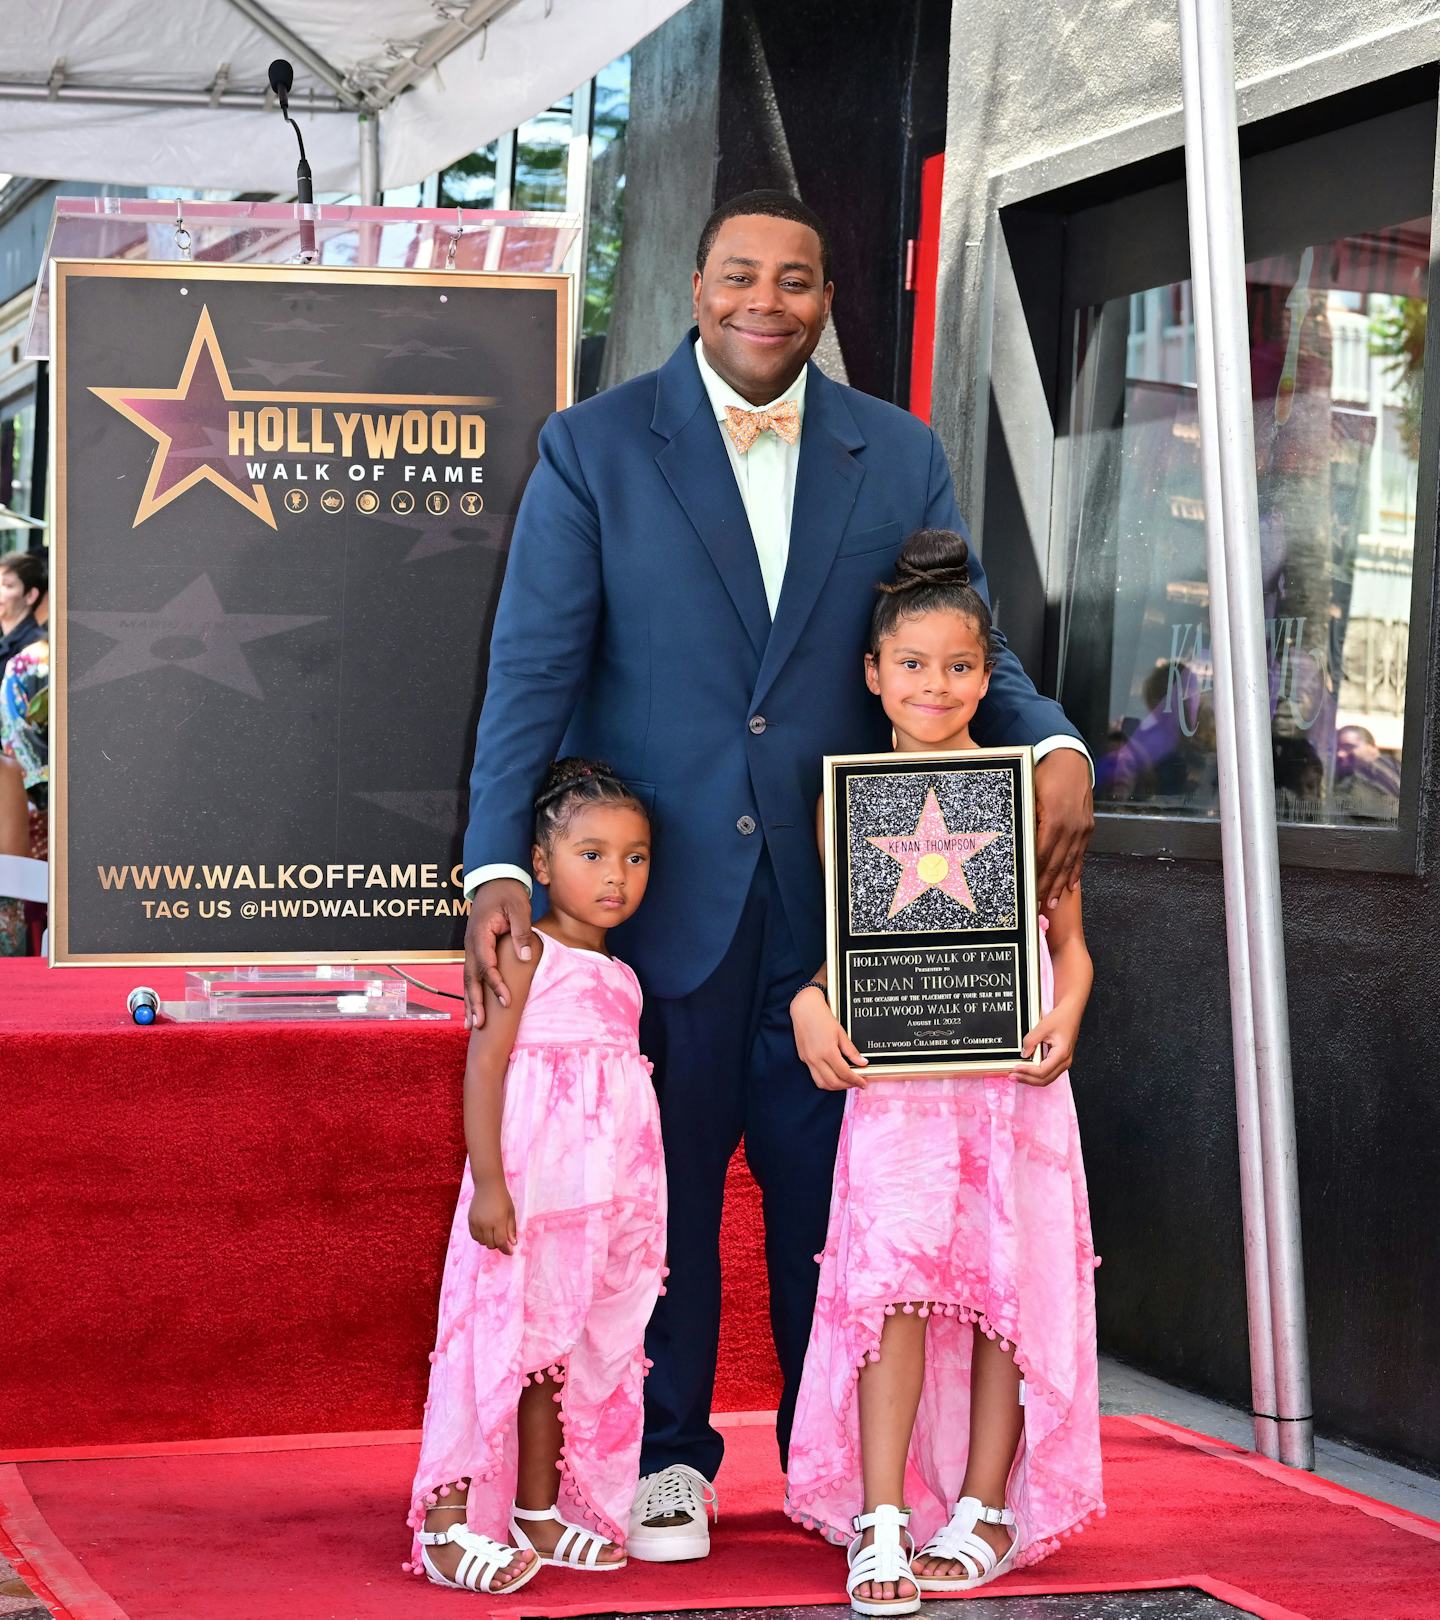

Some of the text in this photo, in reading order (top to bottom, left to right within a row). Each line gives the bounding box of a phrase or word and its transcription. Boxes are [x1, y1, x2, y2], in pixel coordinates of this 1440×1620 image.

[228, 406, 486, 460] HOLLYWOOD
[246, 463, 484, 483] WALK OF FAME
[888, 838, 976, 853] KENAN THOMPSON
[141, 900, 190, 919] TAG
[199, 900, 232, 919] US
[853, 950, 1012, 968] HOLLYWOOD WALK OF FAME
[854, 973, 1012, 993] KENAN THOMPSON
[854, 1001, 1014, 1018] HOLLYWOOD WALK OF FAME
[942, 1018, 962, 1026] 2022
